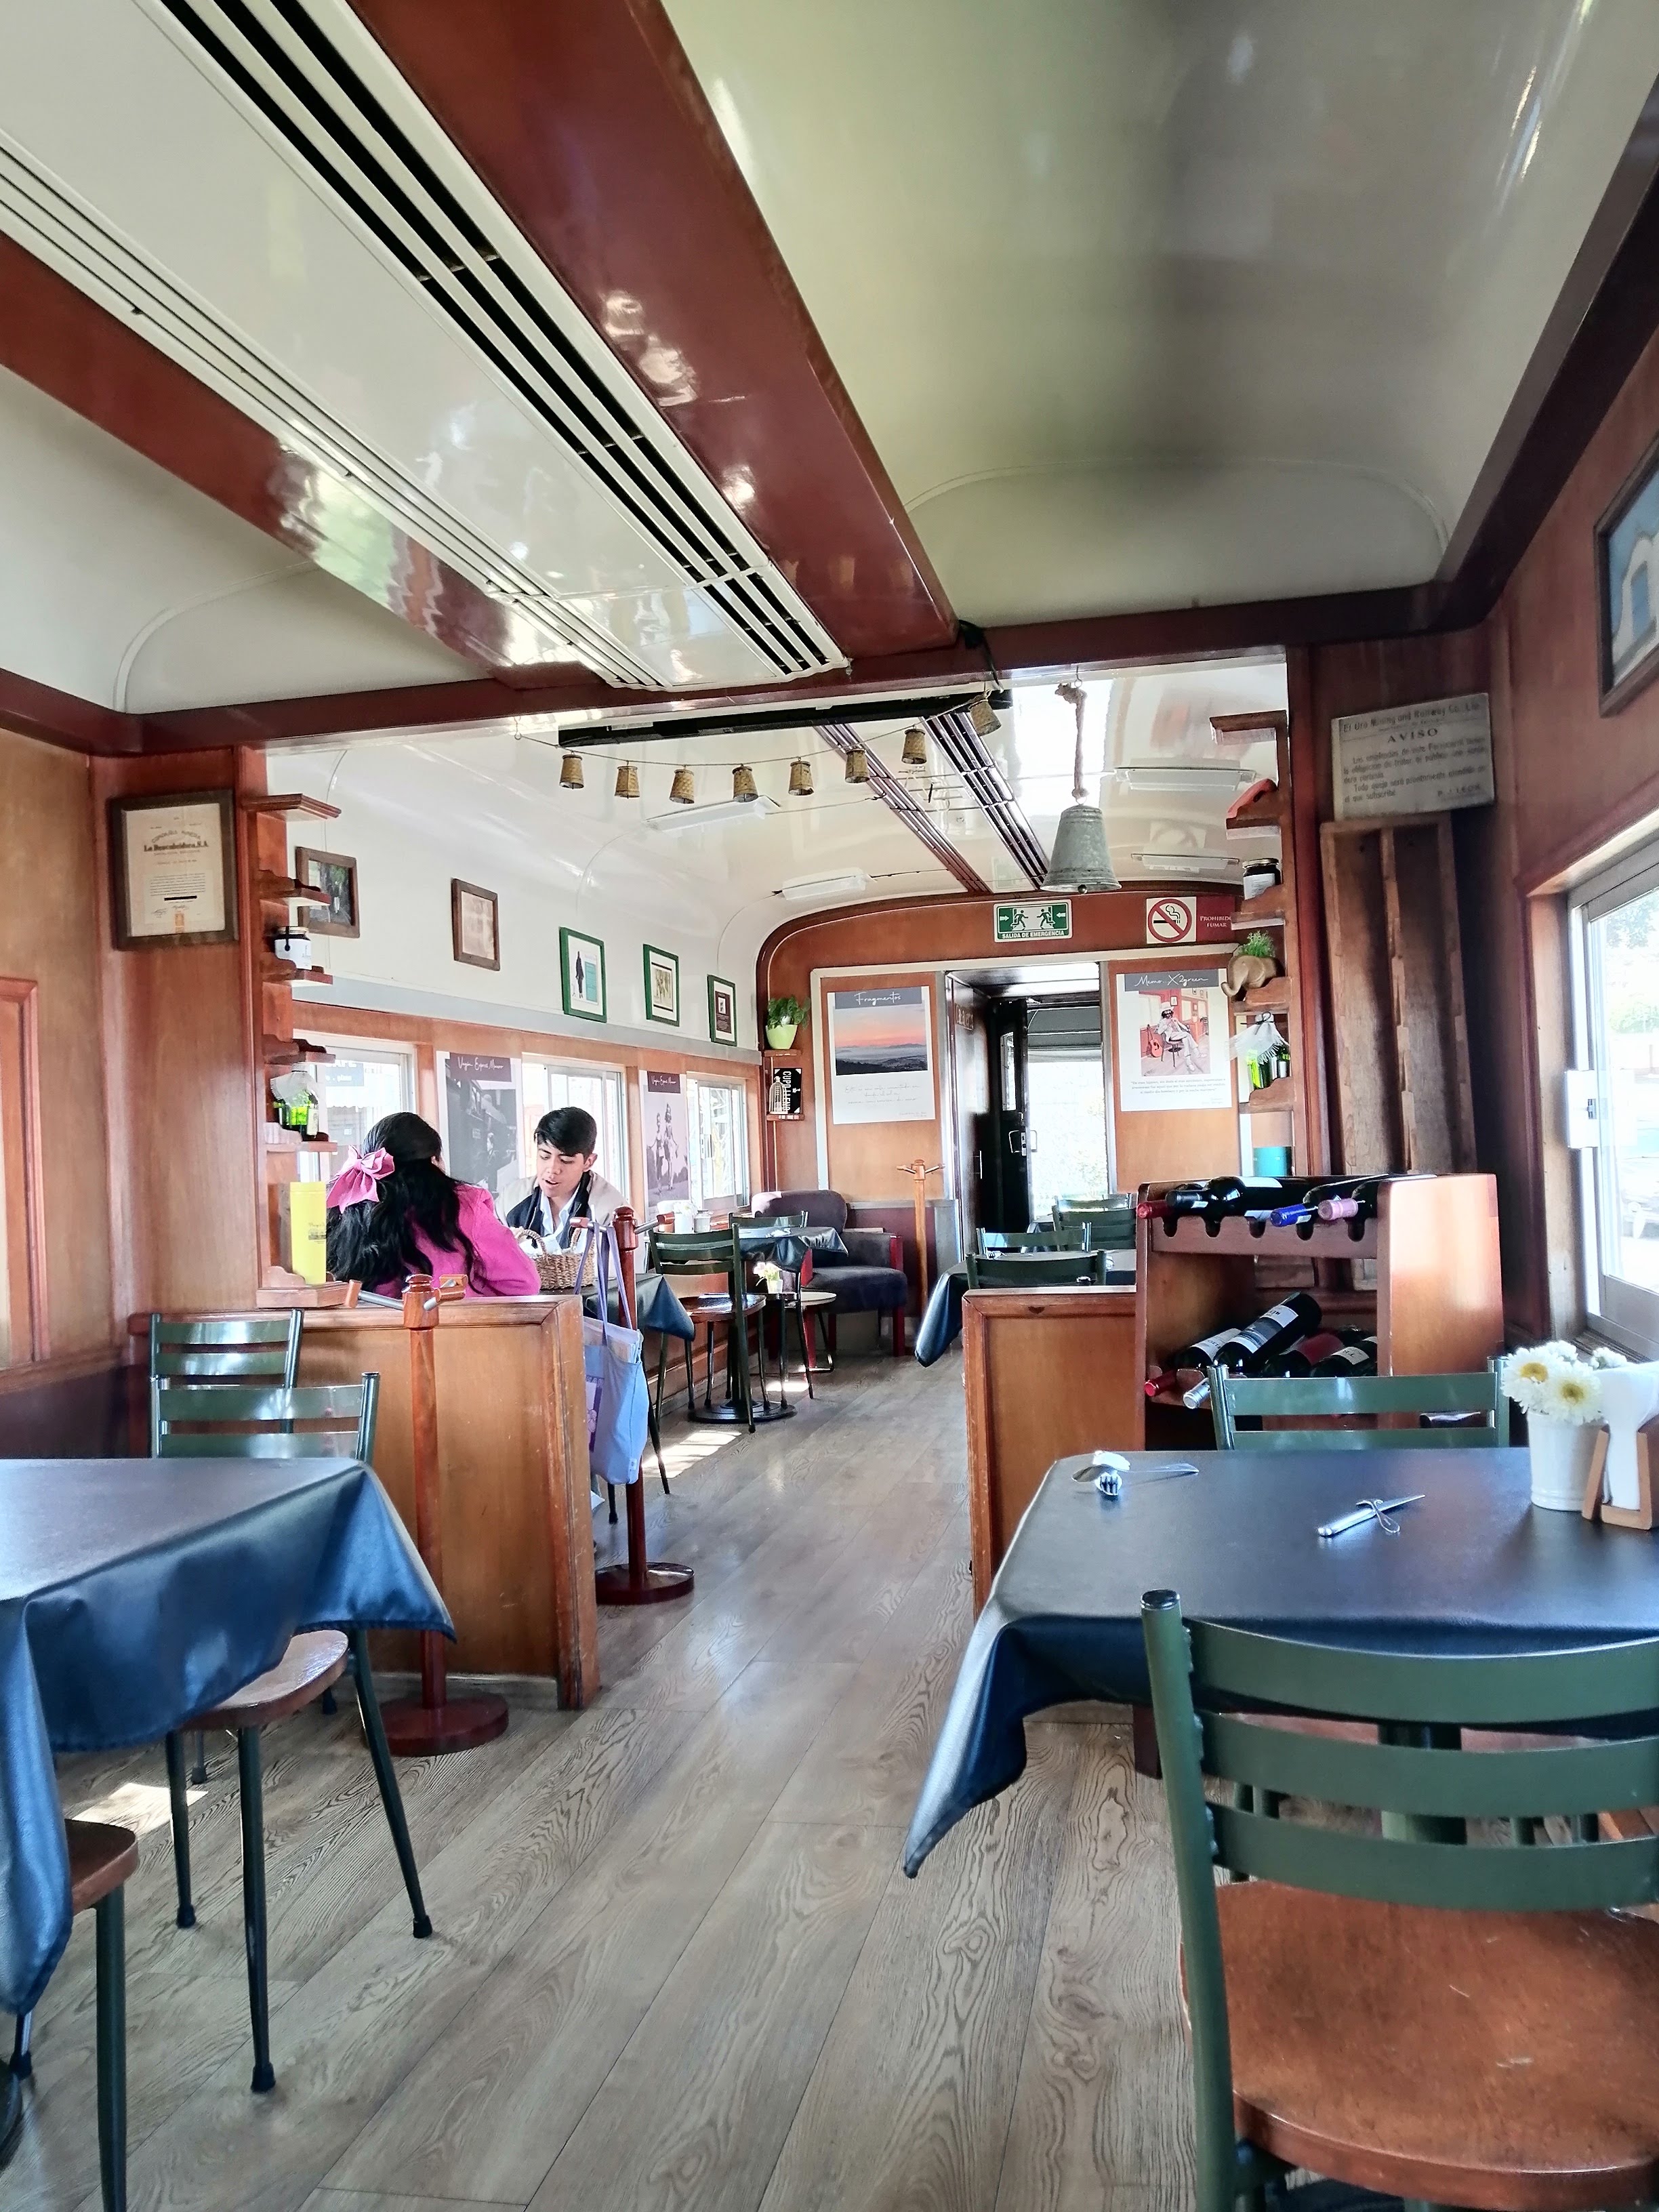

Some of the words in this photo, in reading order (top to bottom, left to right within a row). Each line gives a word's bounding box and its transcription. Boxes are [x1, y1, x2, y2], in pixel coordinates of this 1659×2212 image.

[1387, 728, 1438, 743] AVISO
[853, 991, 902, 1006] Fragmentos
[782, 1071, 792, 1088] CUPO
